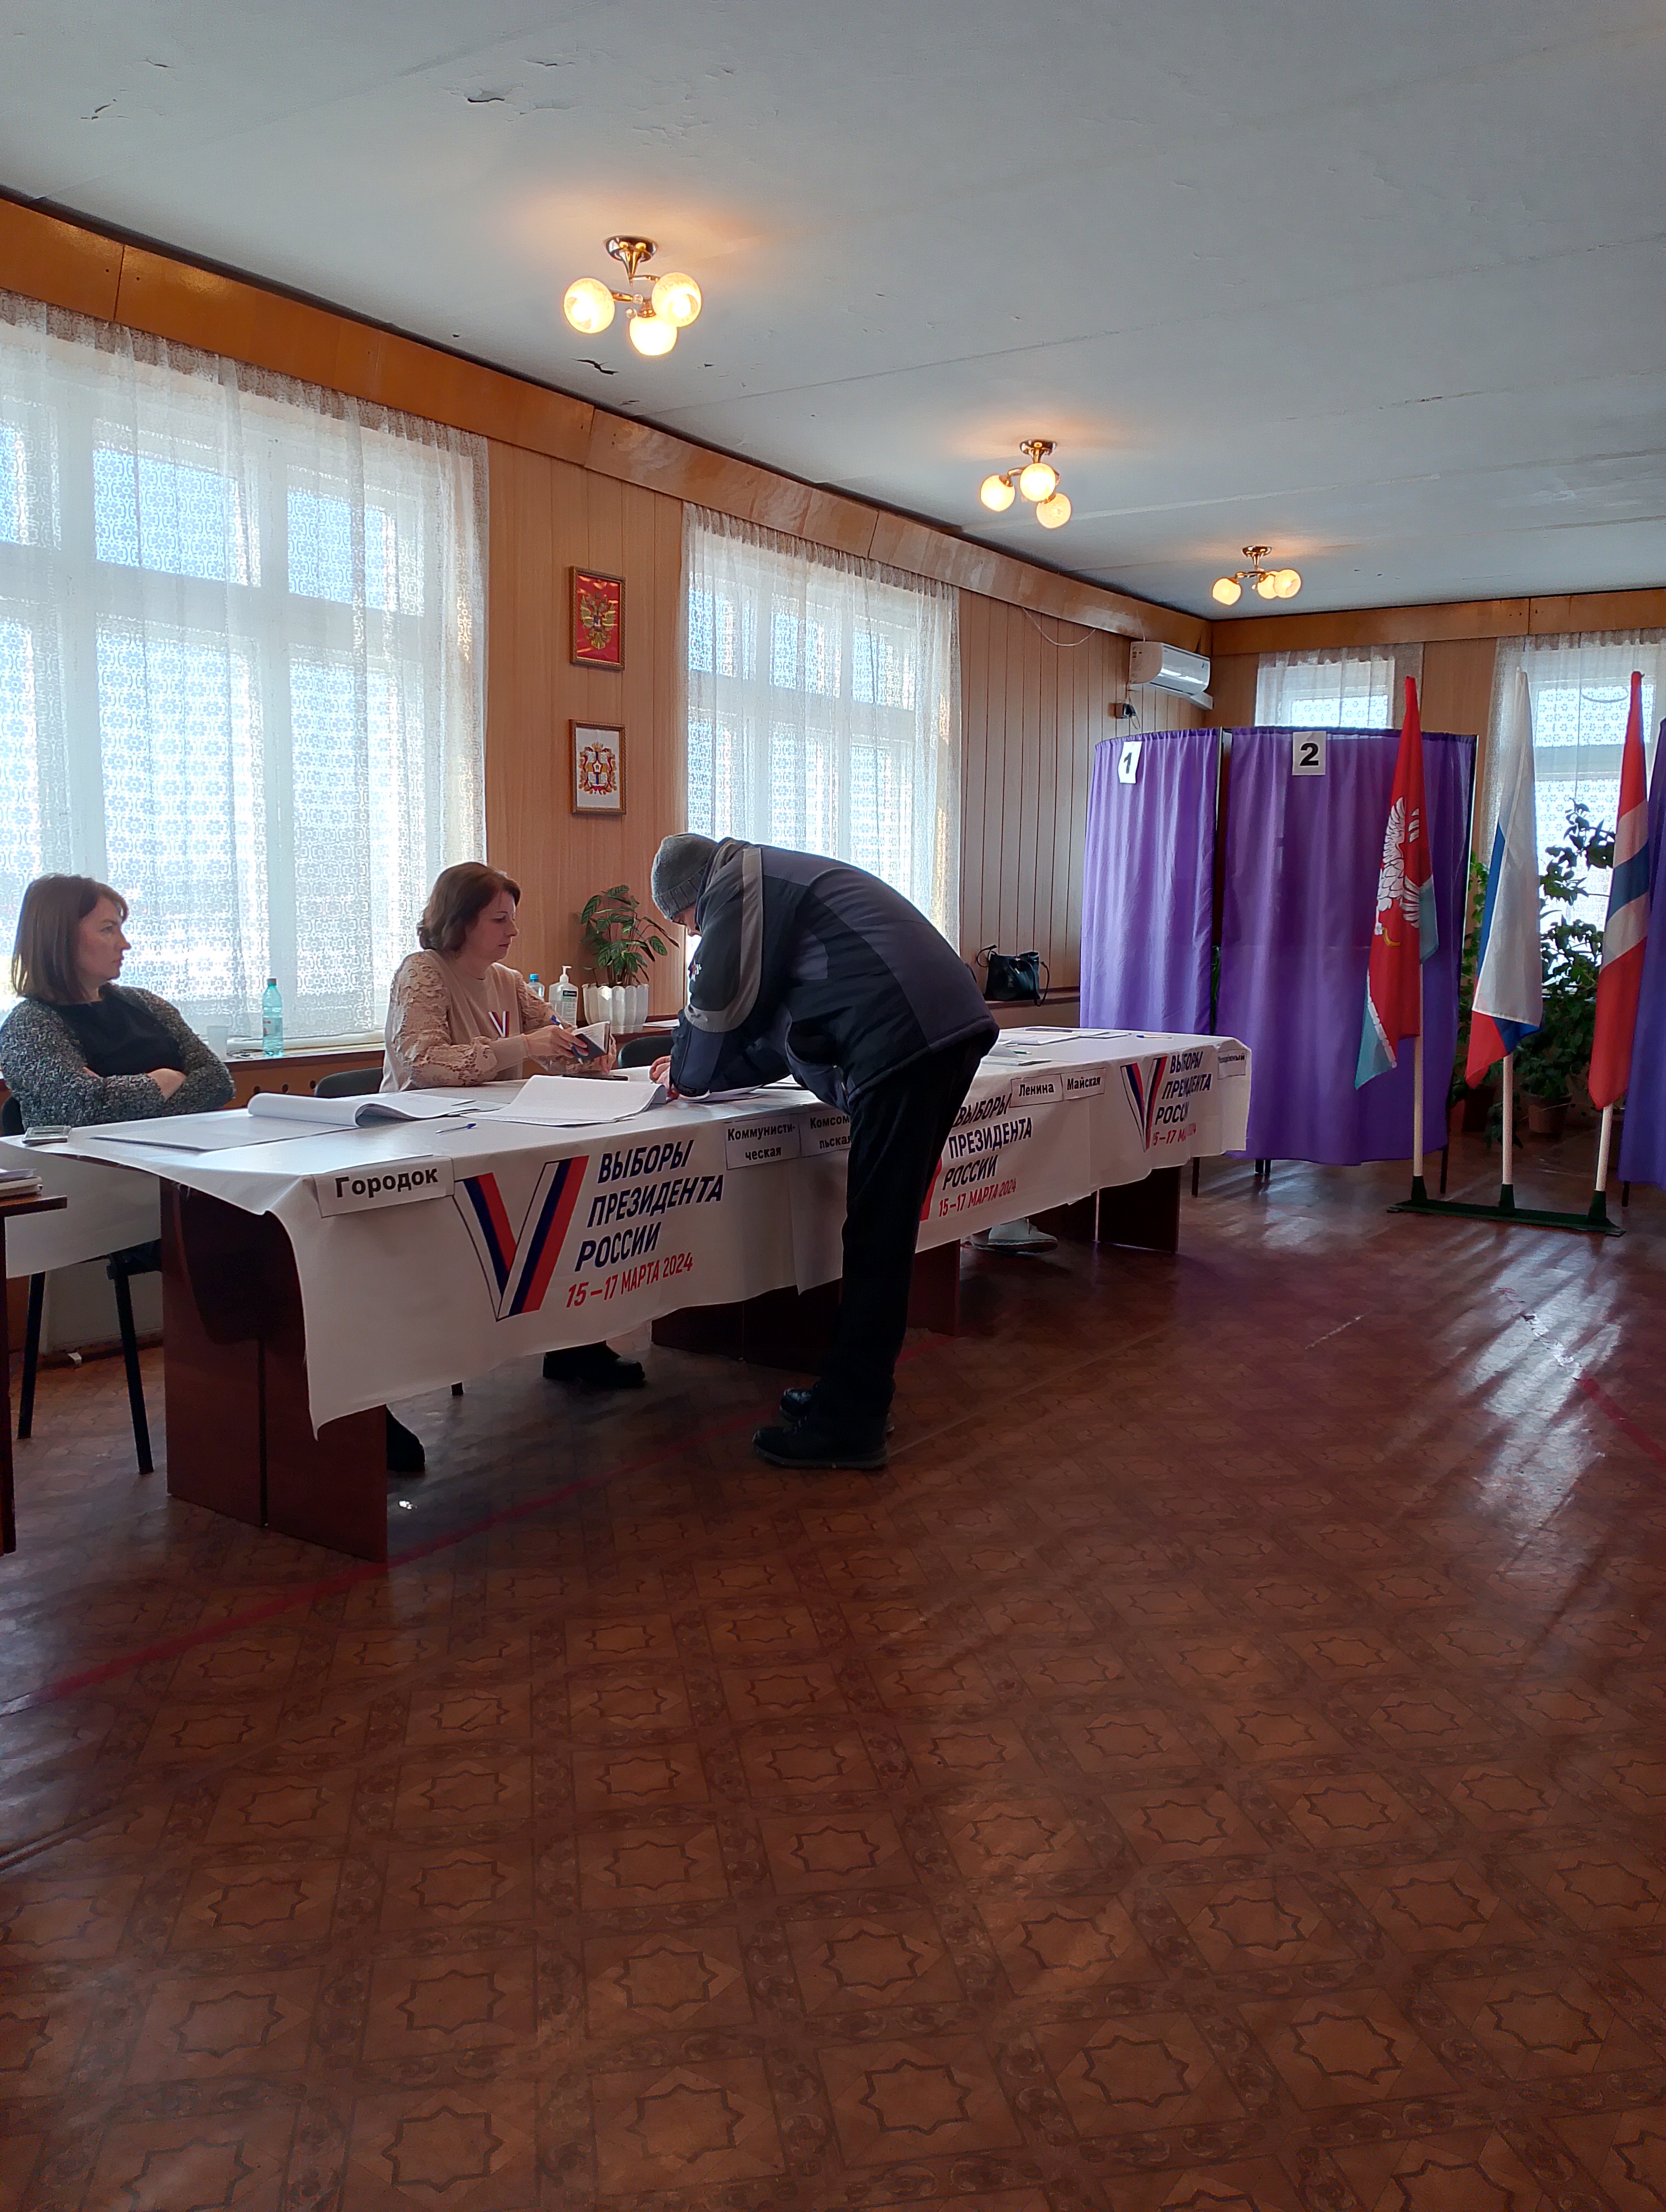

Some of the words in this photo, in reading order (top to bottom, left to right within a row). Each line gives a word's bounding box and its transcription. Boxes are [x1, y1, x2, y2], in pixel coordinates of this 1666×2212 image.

[1123, 752, 1132, 774] 1
[1299, 743, 1319, 766] 2
[1018, 1084, 1054, 1097] Ленина
[1067, 1076, 1100, 1091] Майская
[810, 1115, 850, 1129] Комсом
[952, 1093, 1013, 1128] ВЫБОРЫ
[727, 1123, 796, 1141] Коммунисти-
[949, 1117, 1033, 1159] ПРЕЗИДЕНТА
[597, 1139, 695, 1184] ВЫБОРЫ
[745, 1147, 781, 1161] ческая
[335, 1168, 438, 1198] Городок
[942, 1155, 998, 1191] РОССИИ
[587, 1174, 723, 1228] ПРЕЗИДЕНТА
[967, 1184, 998, 1208] МАРТА
[998, 1178, 1016, 1197] 2024
[574, 1221, 662, 1272] РОССИИ
[620, 1259, 660, 1295] МАРТА
[663, 1252, 694, 1278] 2024
